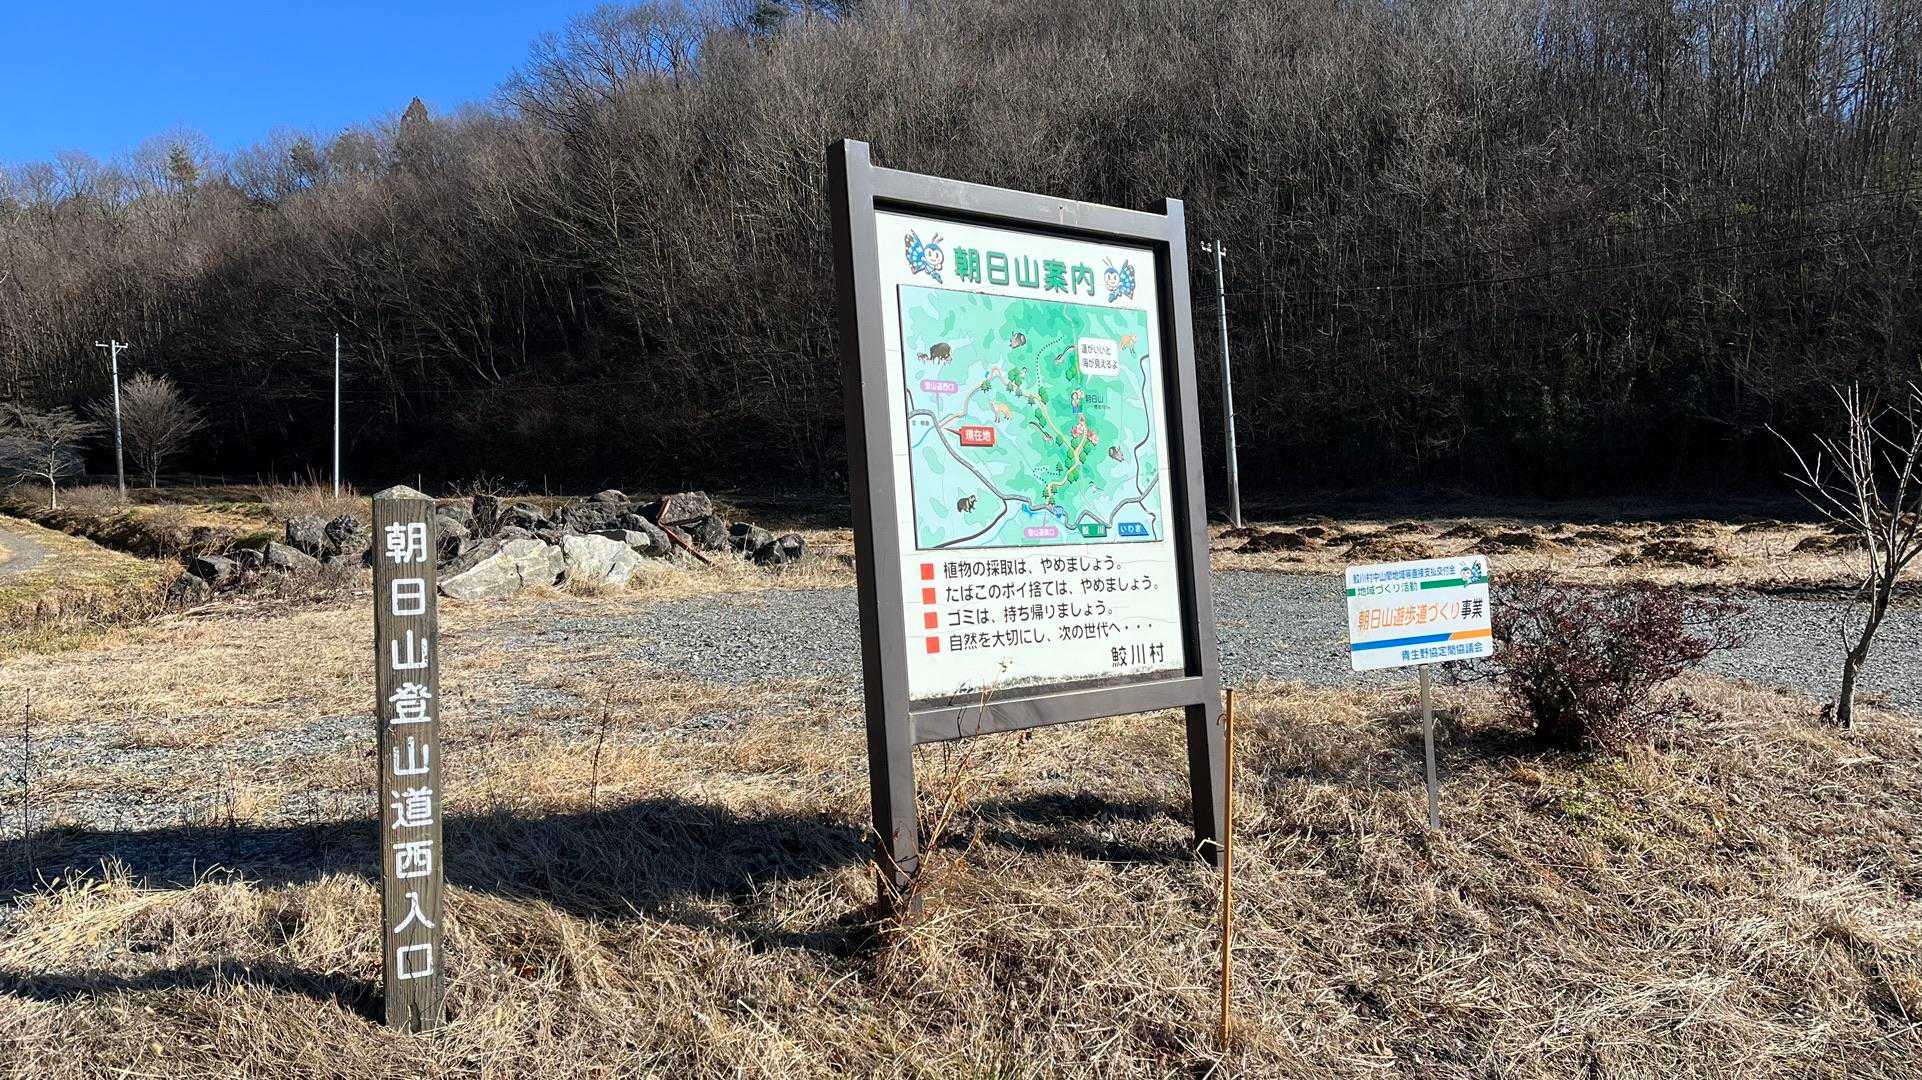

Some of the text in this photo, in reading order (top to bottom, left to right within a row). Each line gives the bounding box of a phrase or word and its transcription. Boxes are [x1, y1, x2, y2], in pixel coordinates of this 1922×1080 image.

[953, 247, 1095, 296] 朝日山案内
[965, 429, 991, 442] 現在地
[943, 555, 1122, 579] 植物の採取は、やめましょう。
[1357, 582, 1419, 597] 地域づくり活動
[947, 600, 1113, 626] ゴミは、持ち帰りましょう。
[1111, 642, 1165, 668] 鮫川村
[385, 521, 435, 980] 朝日山登山道西入口
